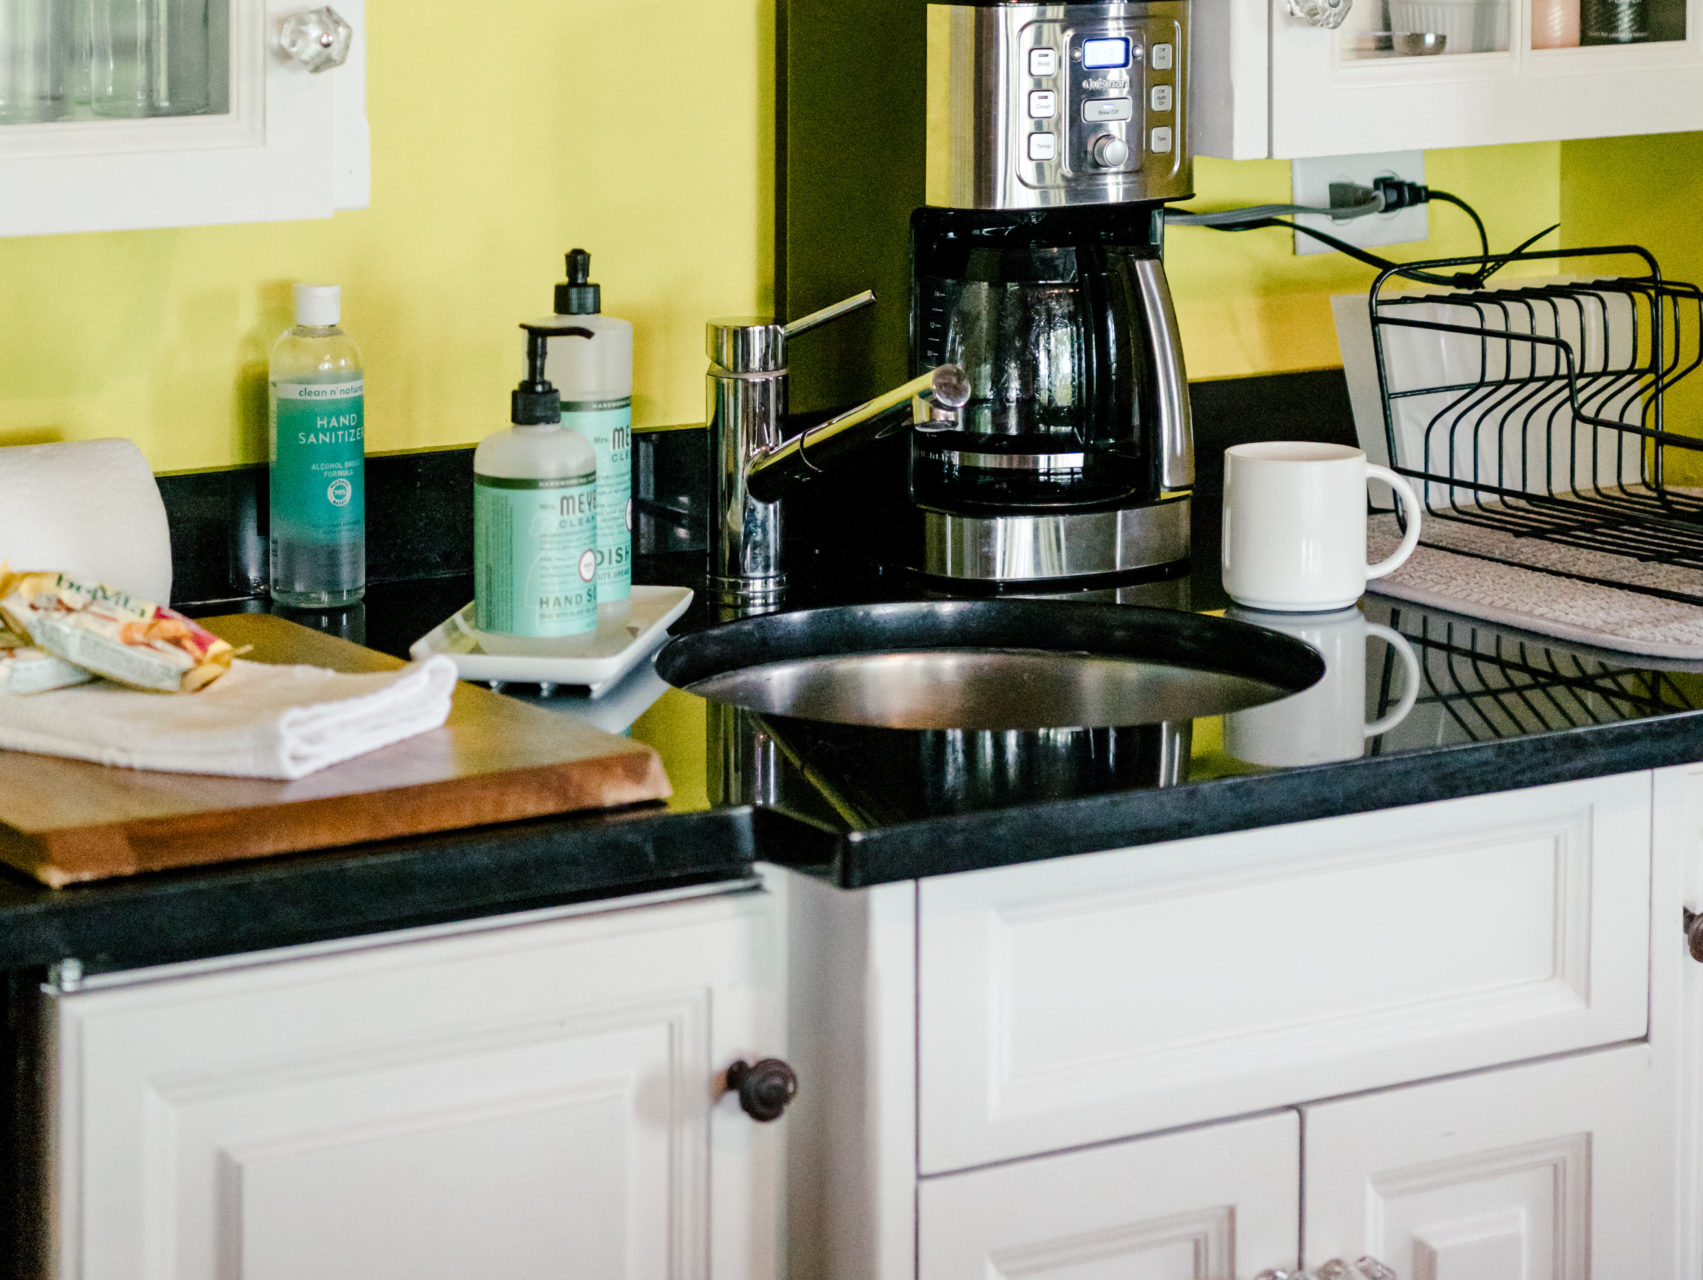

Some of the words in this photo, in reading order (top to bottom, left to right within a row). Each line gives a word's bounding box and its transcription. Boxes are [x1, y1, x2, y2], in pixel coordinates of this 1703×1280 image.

[298, 387, 329, 398] clean
[339, 384, 364, 396] natura
[316, 413, 357, 429] HAND
[611, 424, 630, 451] ME
[611, 450, 630, 463] CLE
[311, 461, 343, 471] ALCOHOL
[323, 468, 354, 478] FORMULA
[559, 489, 597, 517] MEYE
[597, 571, 612, 581] UTS
[539, 593, 583, 609] HAND
[586, 584, 597, 603] SO
